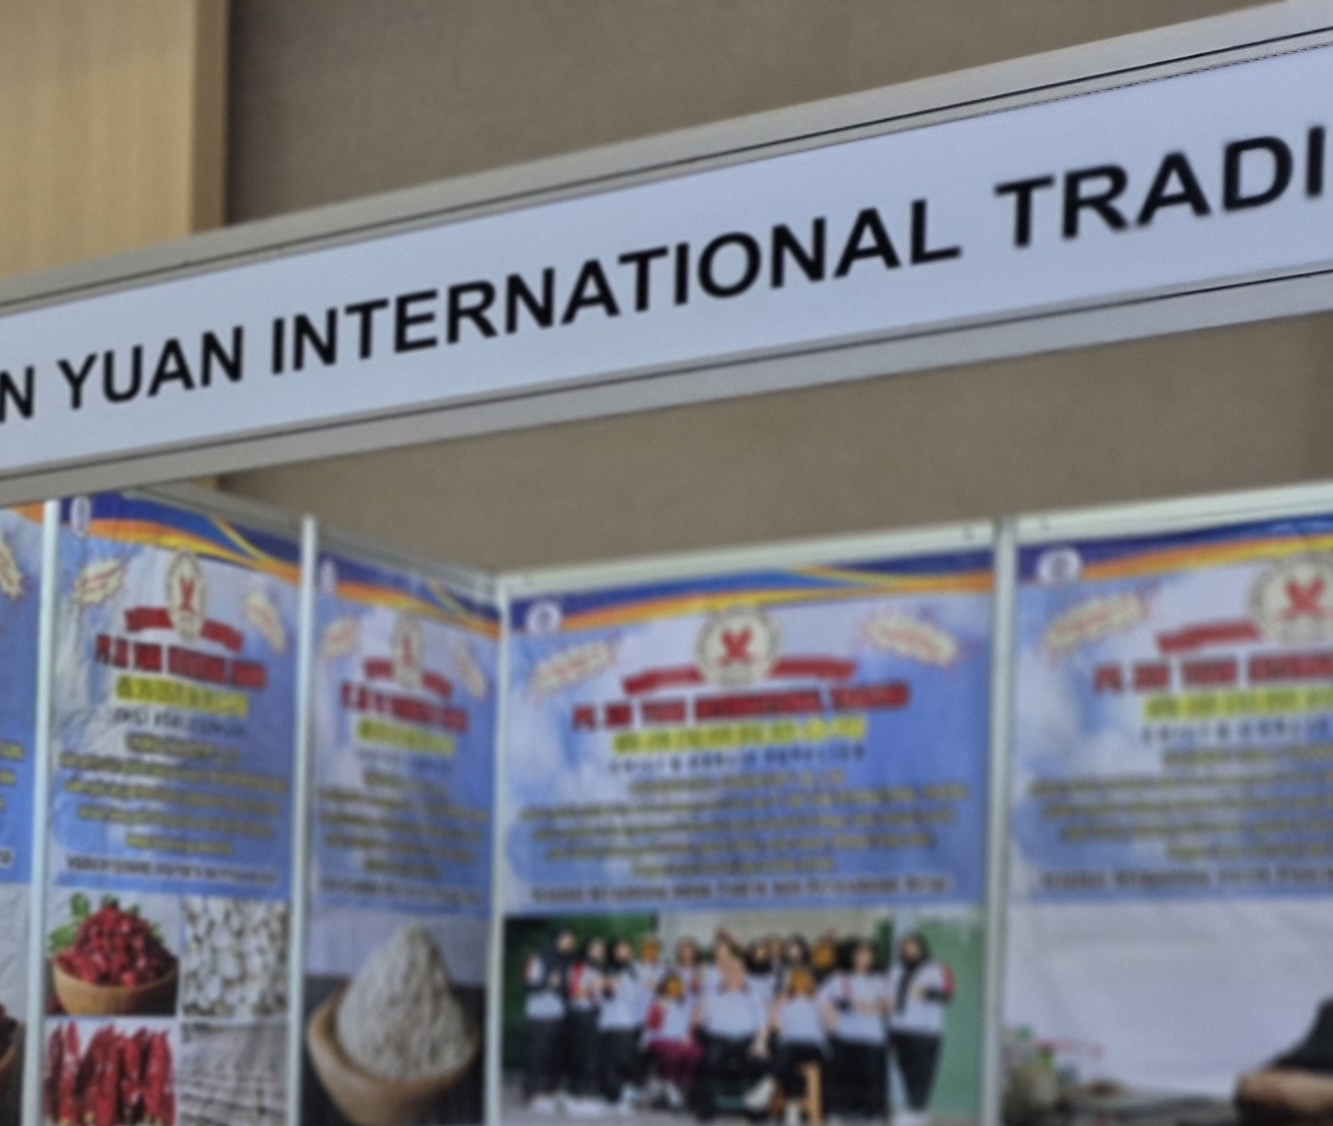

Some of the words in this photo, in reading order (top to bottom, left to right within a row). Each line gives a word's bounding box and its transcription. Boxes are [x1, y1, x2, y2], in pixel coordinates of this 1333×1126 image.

[59, 323, 245, 410] YUAN
[270, 198, 963, 377] INTERNATIONAL
[994, 124, 1327, 250] TRADI
